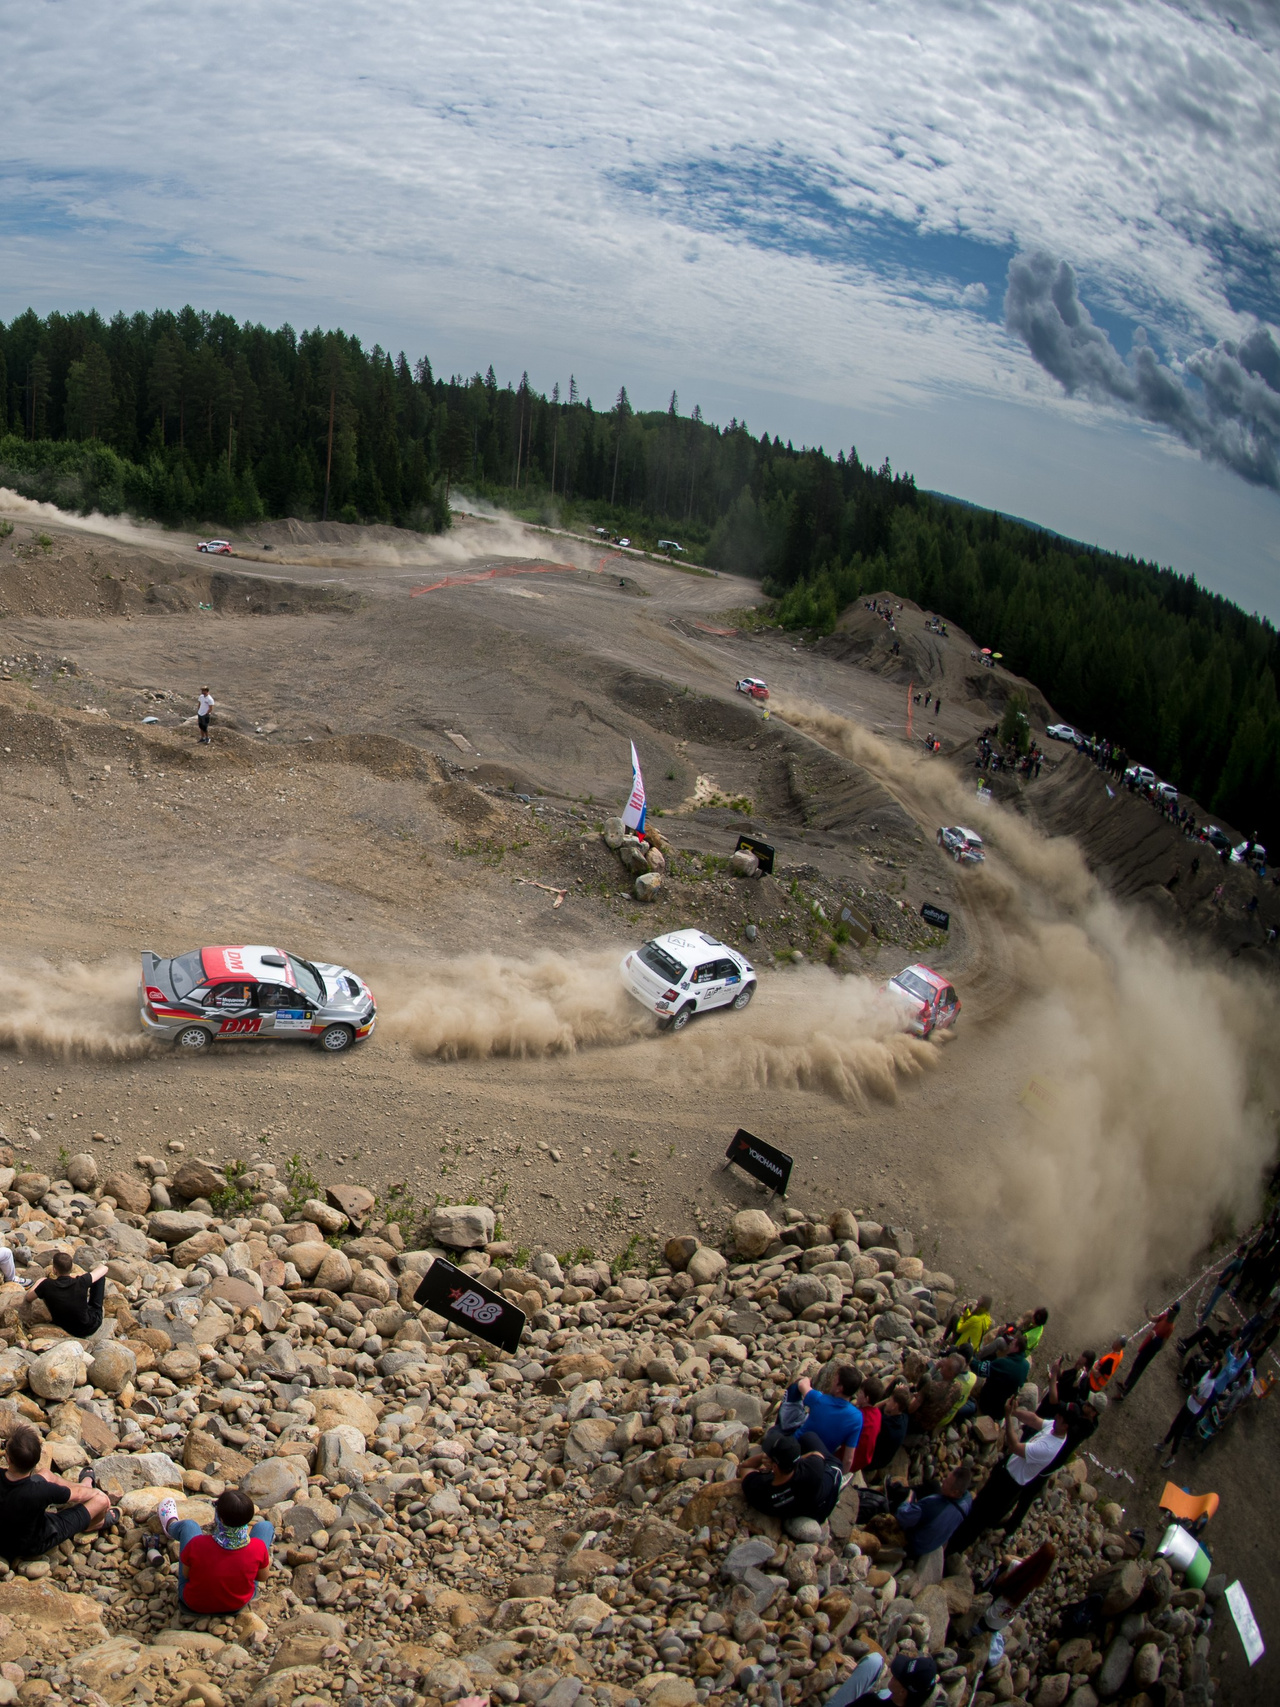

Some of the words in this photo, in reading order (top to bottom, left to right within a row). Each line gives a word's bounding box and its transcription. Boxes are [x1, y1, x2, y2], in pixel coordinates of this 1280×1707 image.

[227, 951, 244, 970] DM
[243, 986, 252, 999] 5
[219, 1018, 263, 1033] DM
[748, 1147, 783, 1178] YOKOHAMA
[450, 1289, 503, 1324] R8
